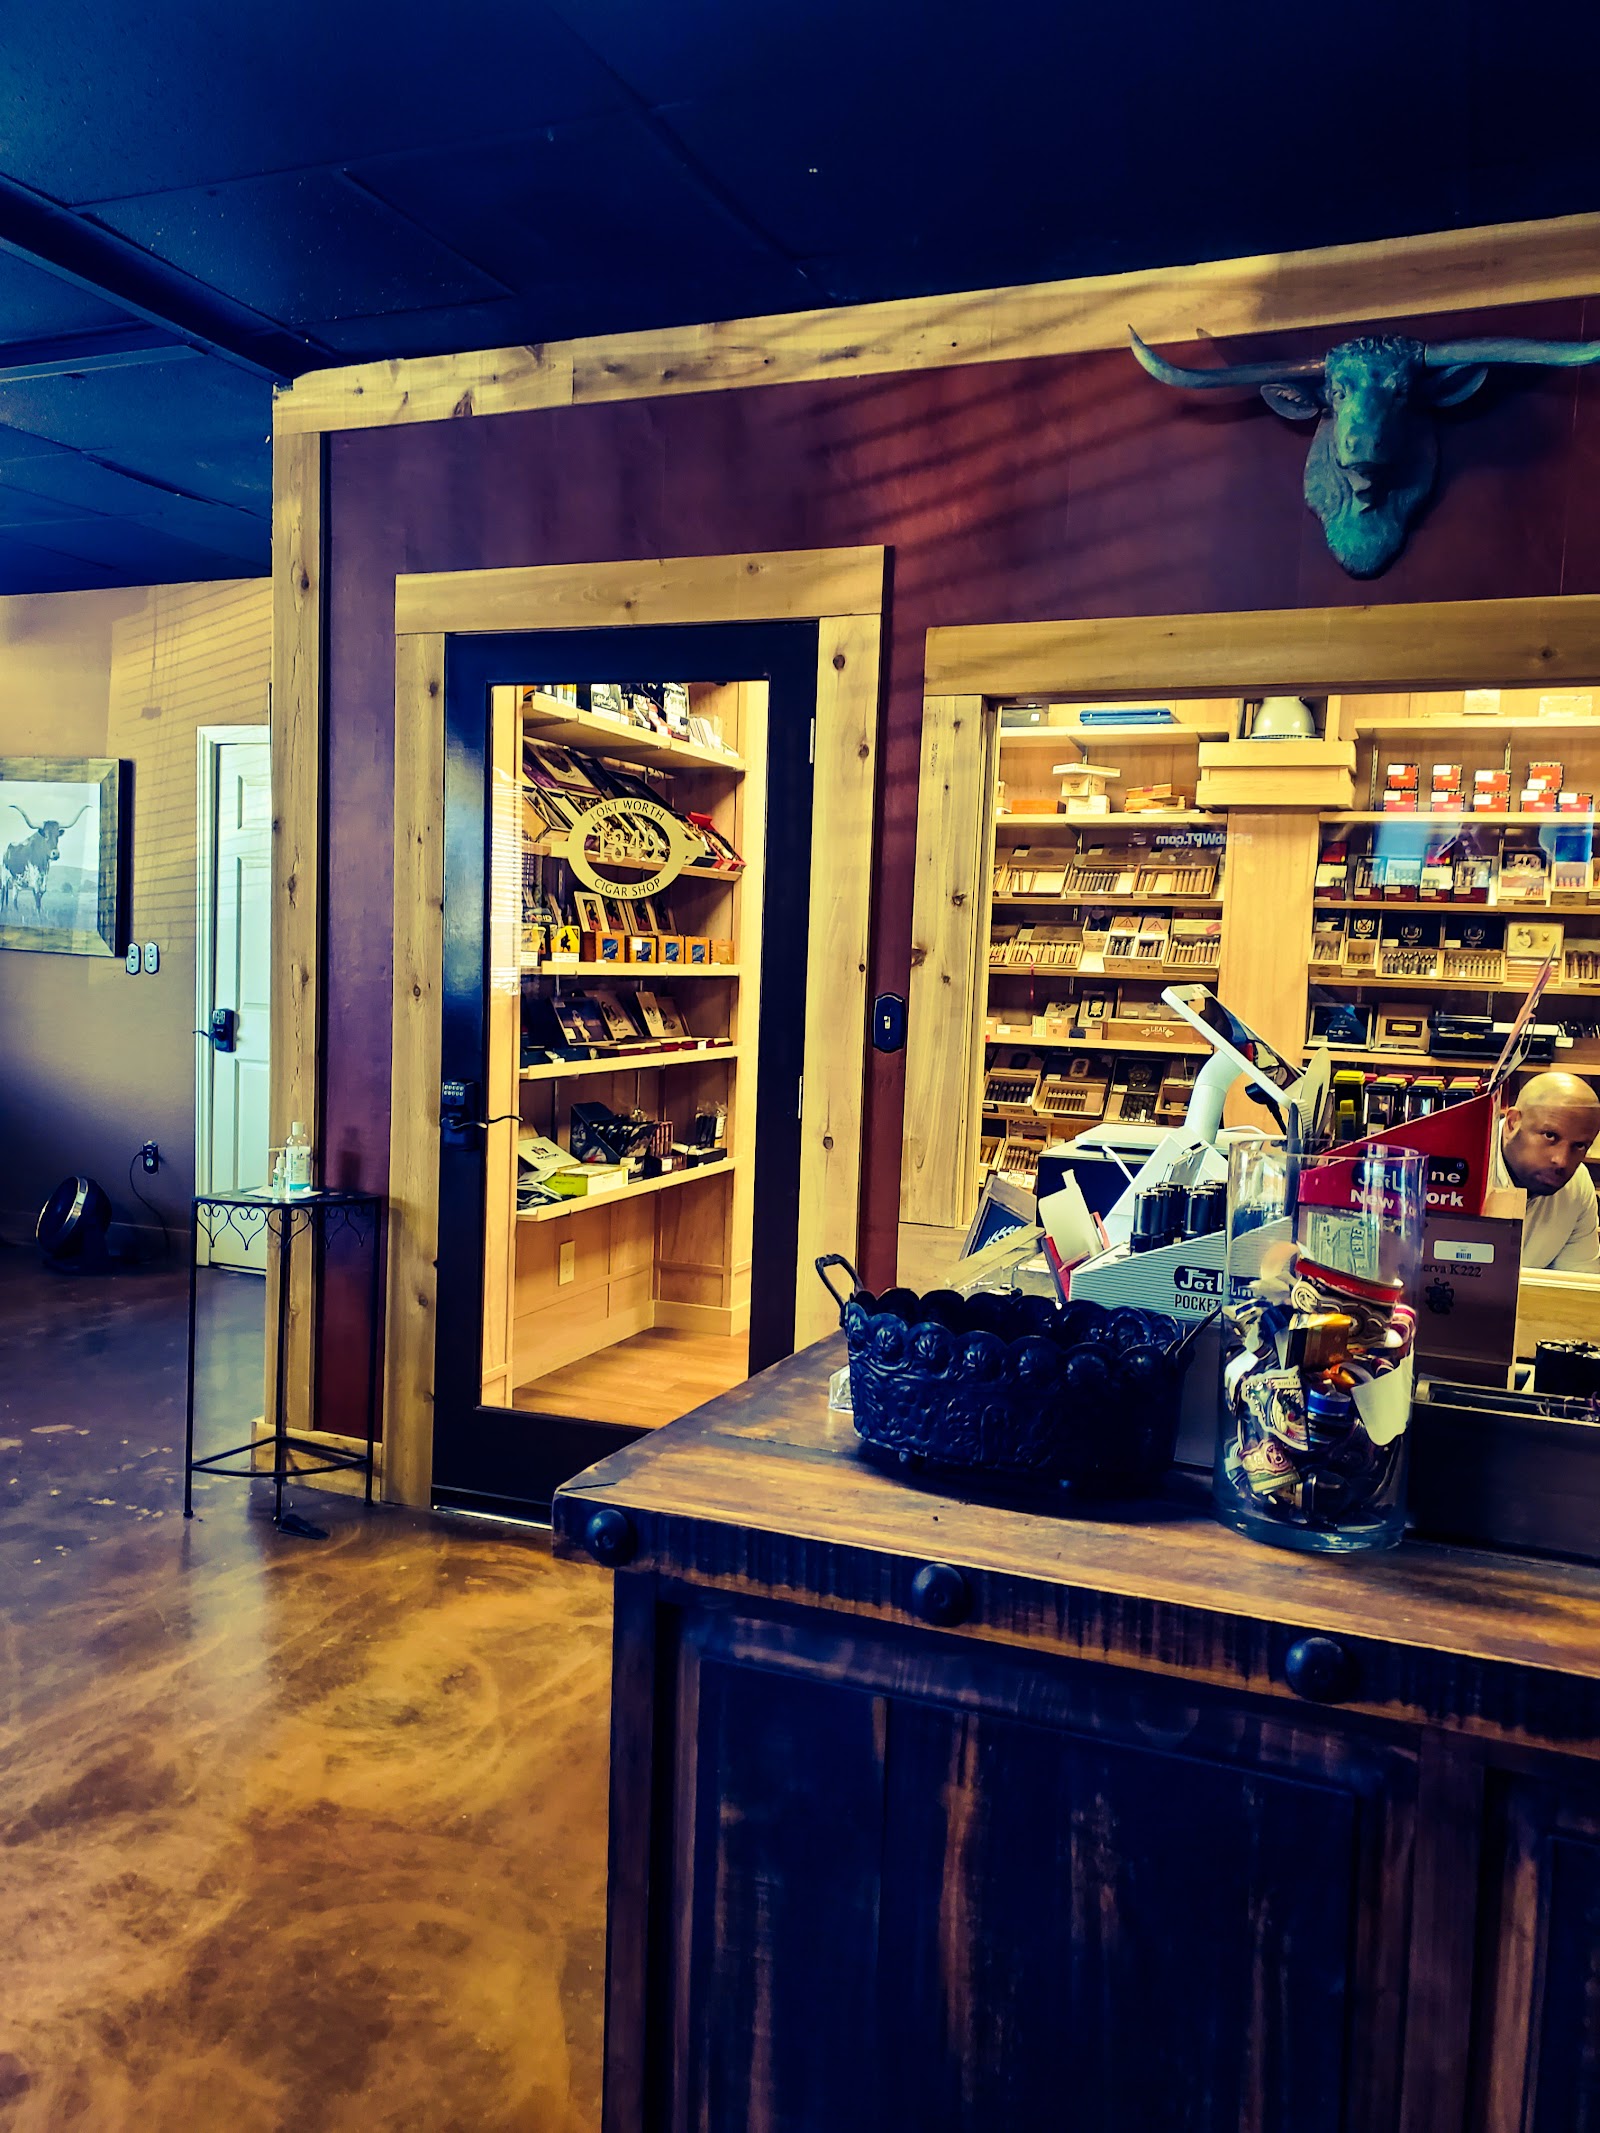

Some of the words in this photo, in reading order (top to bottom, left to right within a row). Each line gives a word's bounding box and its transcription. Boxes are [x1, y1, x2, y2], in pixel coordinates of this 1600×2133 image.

[622, 800, 665, 820] WORTH
[595, 829, 661, 862] 1849
[594, 878, 628, 896] CIGAR
[632, 877, 661, 897] SHOP
[603, 943, 618, 955] ACID
[666, 946, 680, 958] ACID
[1350, 1189, 1395, 1210] New
[1450, 1264, 1482, 1278] K222
[1175, 1294, 1221, 1312] POCKET
